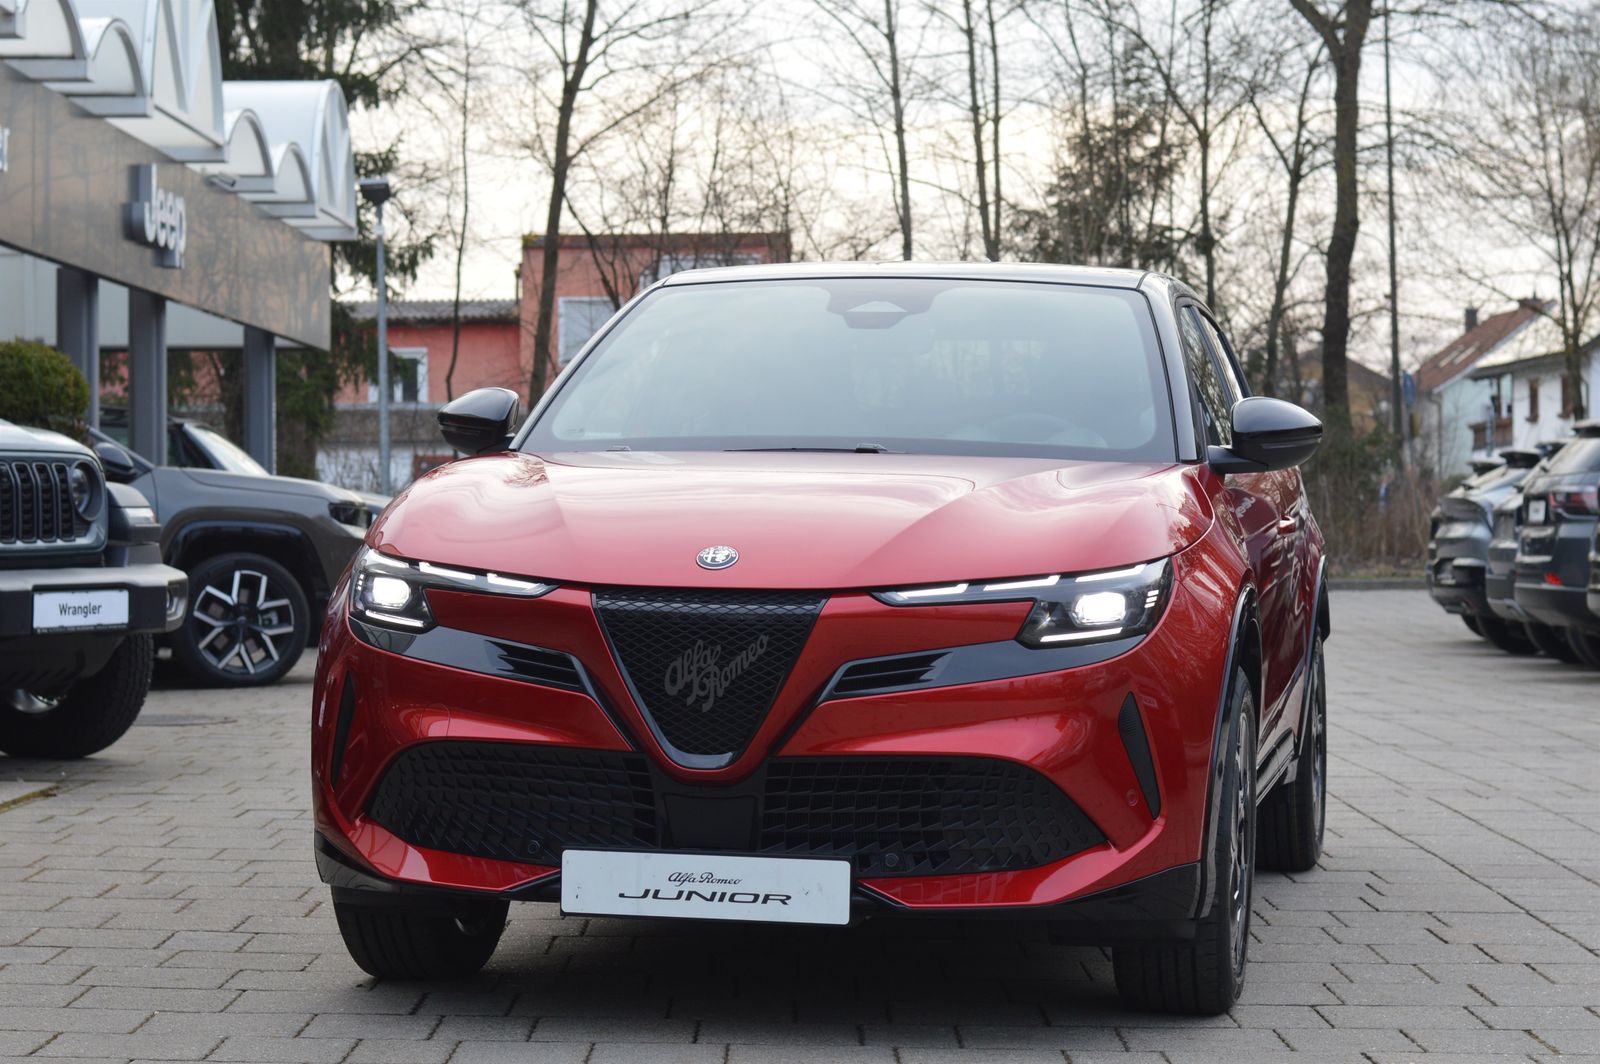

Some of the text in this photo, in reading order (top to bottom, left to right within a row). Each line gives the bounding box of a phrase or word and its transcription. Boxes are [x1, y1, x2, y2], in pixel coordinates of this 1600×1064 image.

[144, 163, 187, 269] Jeep
[58, 602, 102, 619] Wrangler
[664, 635, 768, 713] Alfa Romeo
[668, 871, 742, 888] Alfa Romeo
[618, 888, 792, 906] JUNIOR
